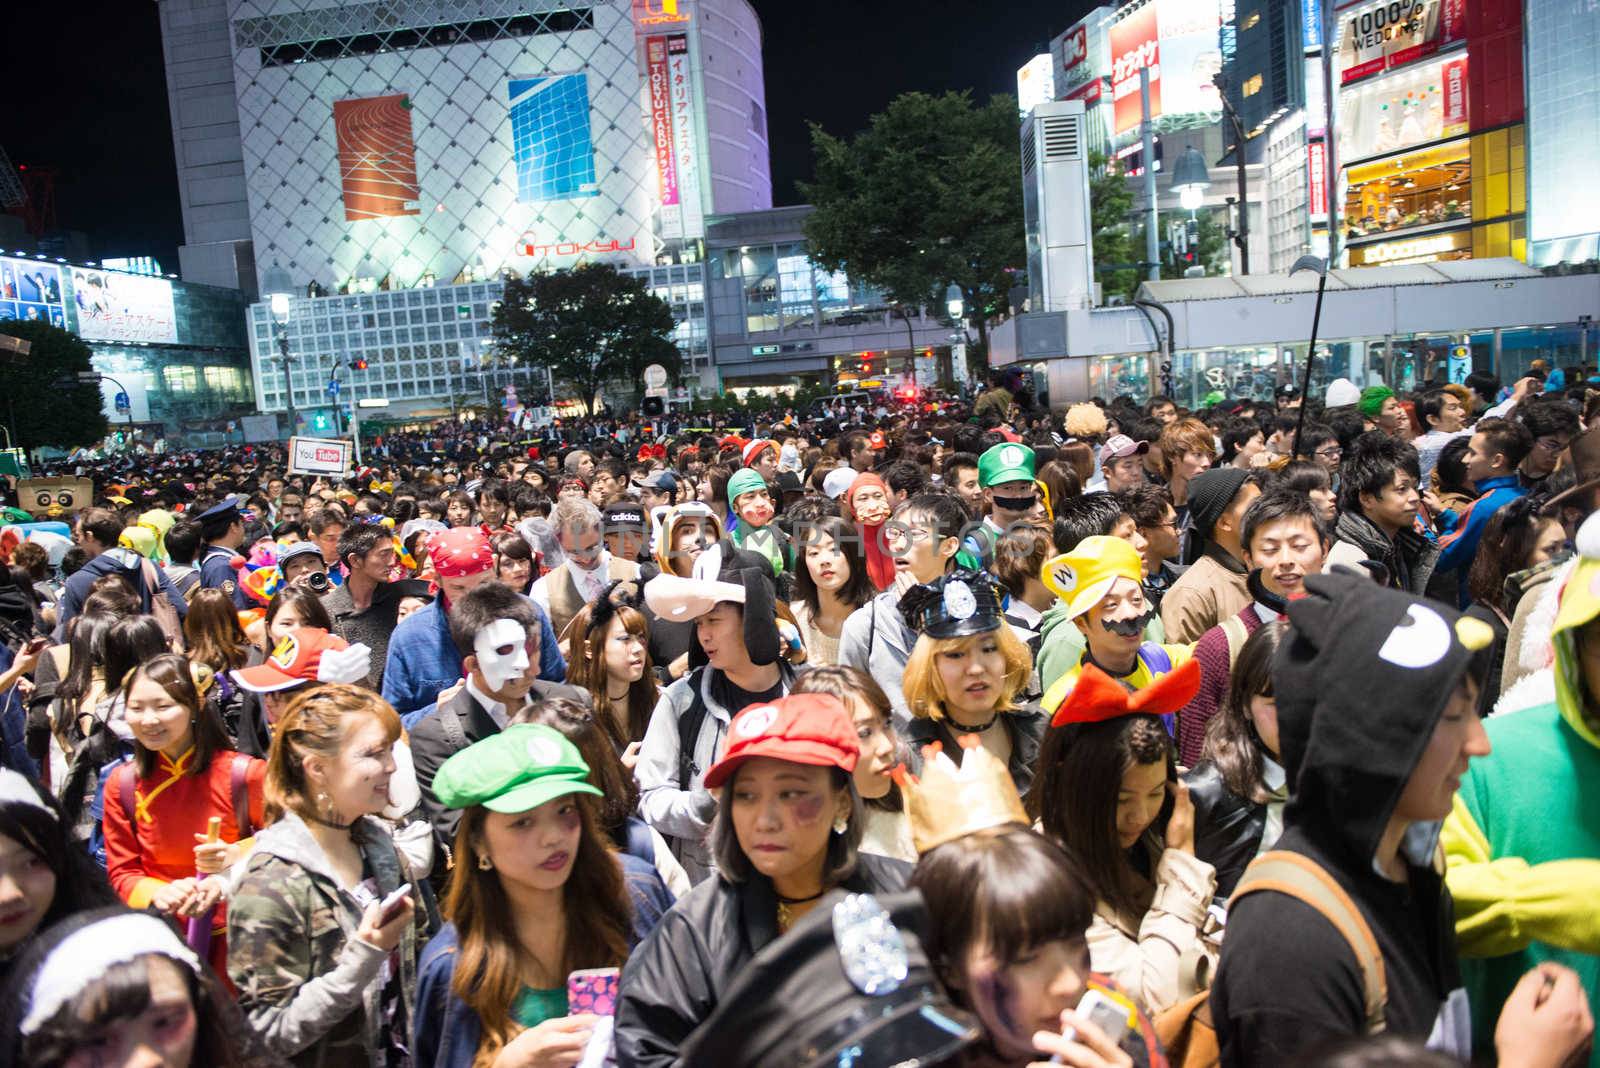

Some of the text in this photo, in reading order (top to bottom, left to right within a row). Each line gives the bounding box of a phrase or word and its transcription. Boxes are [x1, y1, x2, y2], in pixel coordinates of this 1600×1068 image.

[1112, 39, 1159, 83] カラオケ
[534, 237, 635, 257] TOKYU
[611, 512, 640, 522] adidas
[1053, 563, 1073, 585] W
